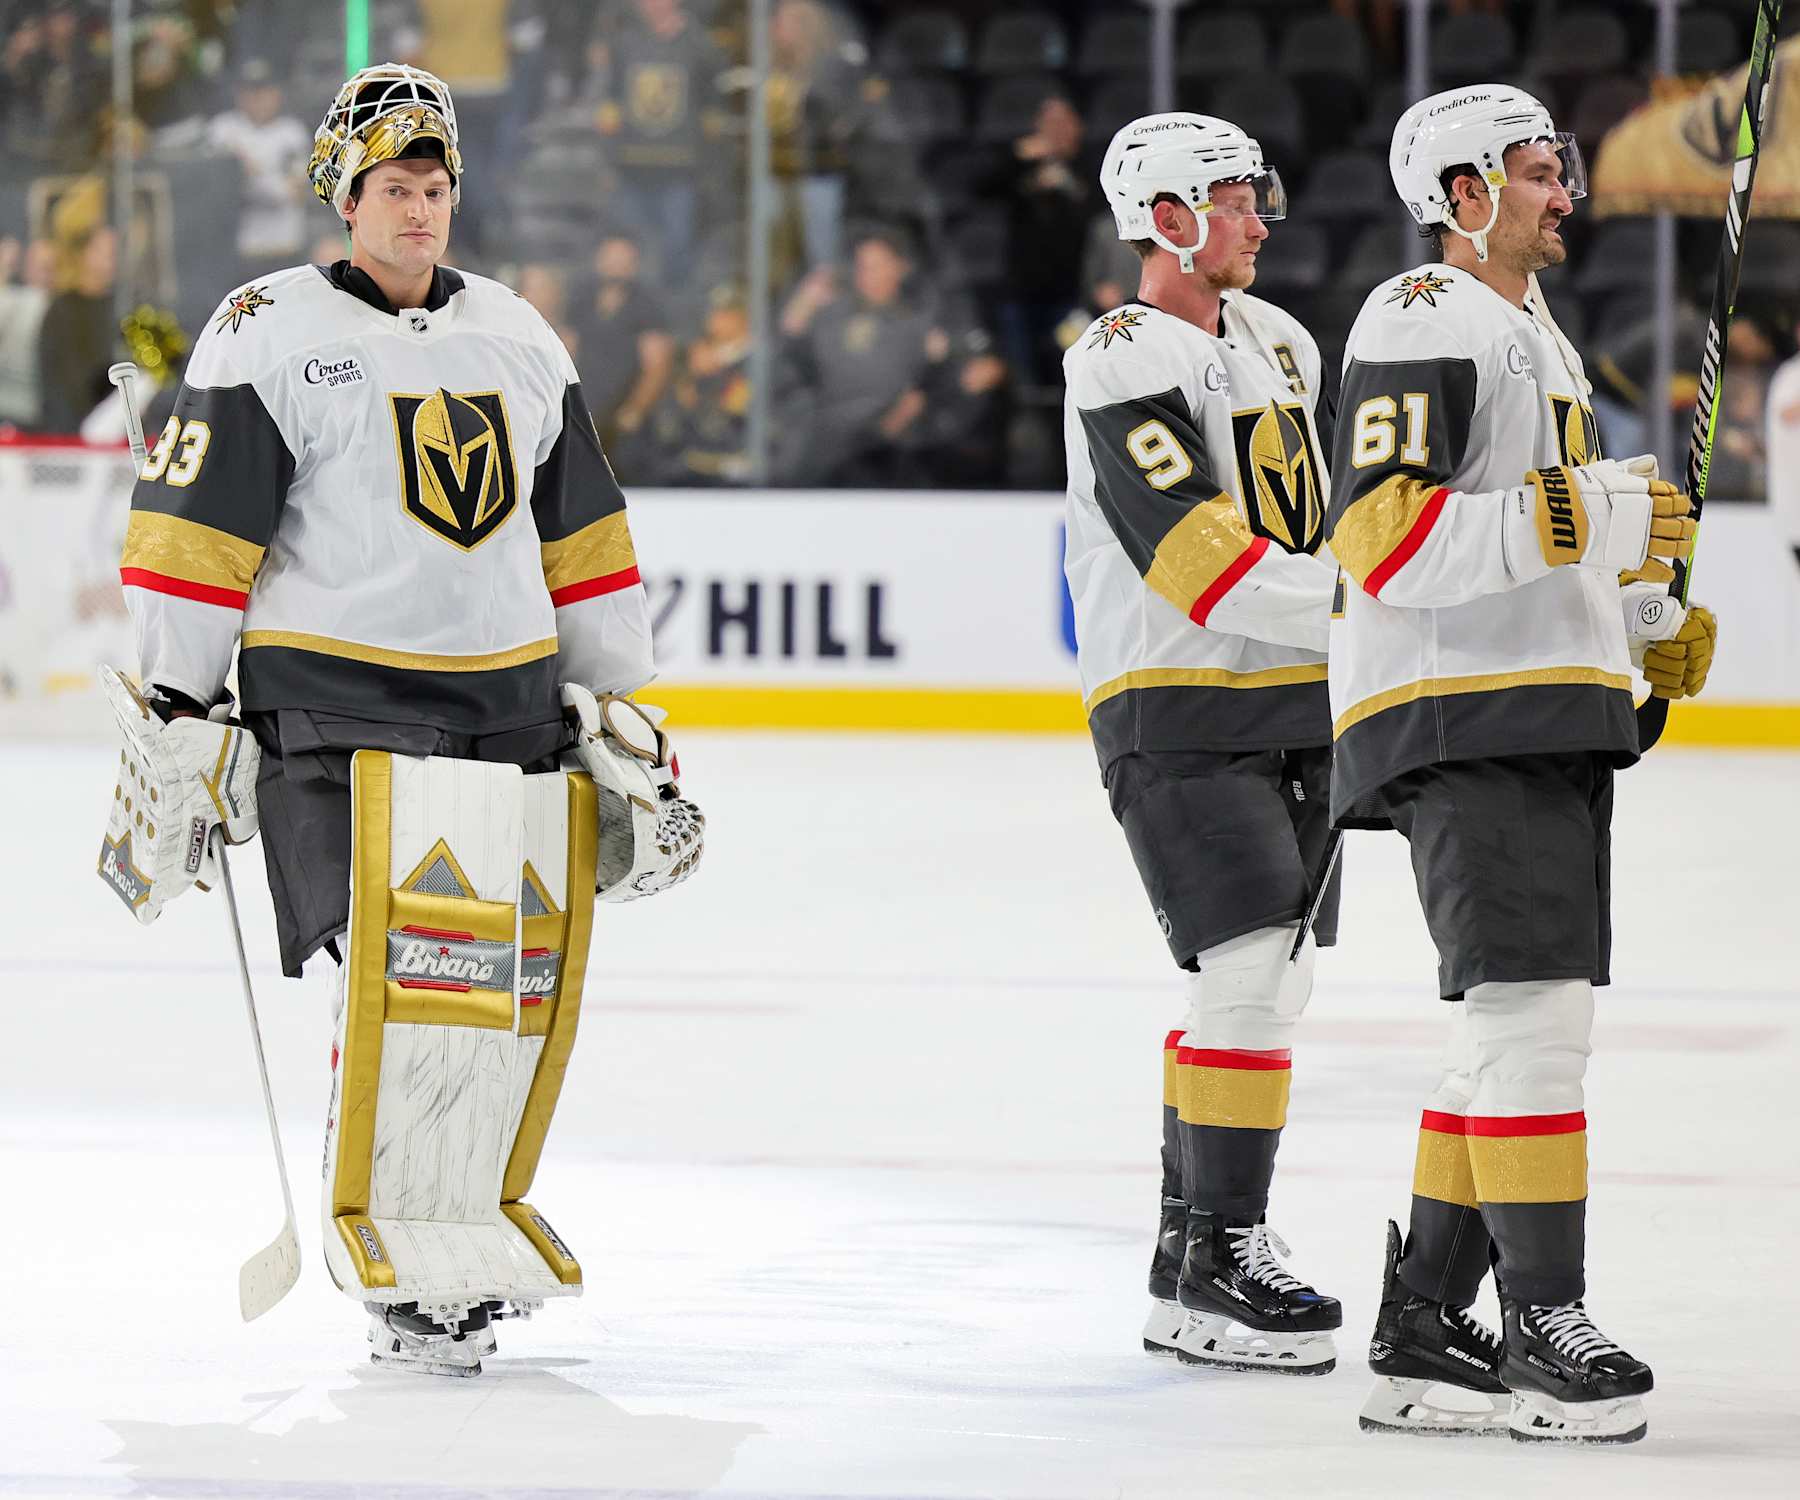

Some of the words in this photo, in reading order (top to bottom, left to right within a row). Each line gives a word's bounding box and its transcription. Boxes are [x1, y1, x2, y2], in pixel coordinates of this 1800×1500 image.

[1429, 94, 1491, 117] CreditOne
[304, 359, 357, 384] Circa
[327, 370, 363, 387] SPORTS
[140, 415, 212, 488] 33
[1352, 392, 1430, 470] 61
[1126, 418, 1194, 491] 9
[708, 582, 896, 658] HILL
[103, 849, 138, 901] Brian's
[394, 941, 495, 981] Brian's
[1445, 1346, 1492, 1372] BAUER
